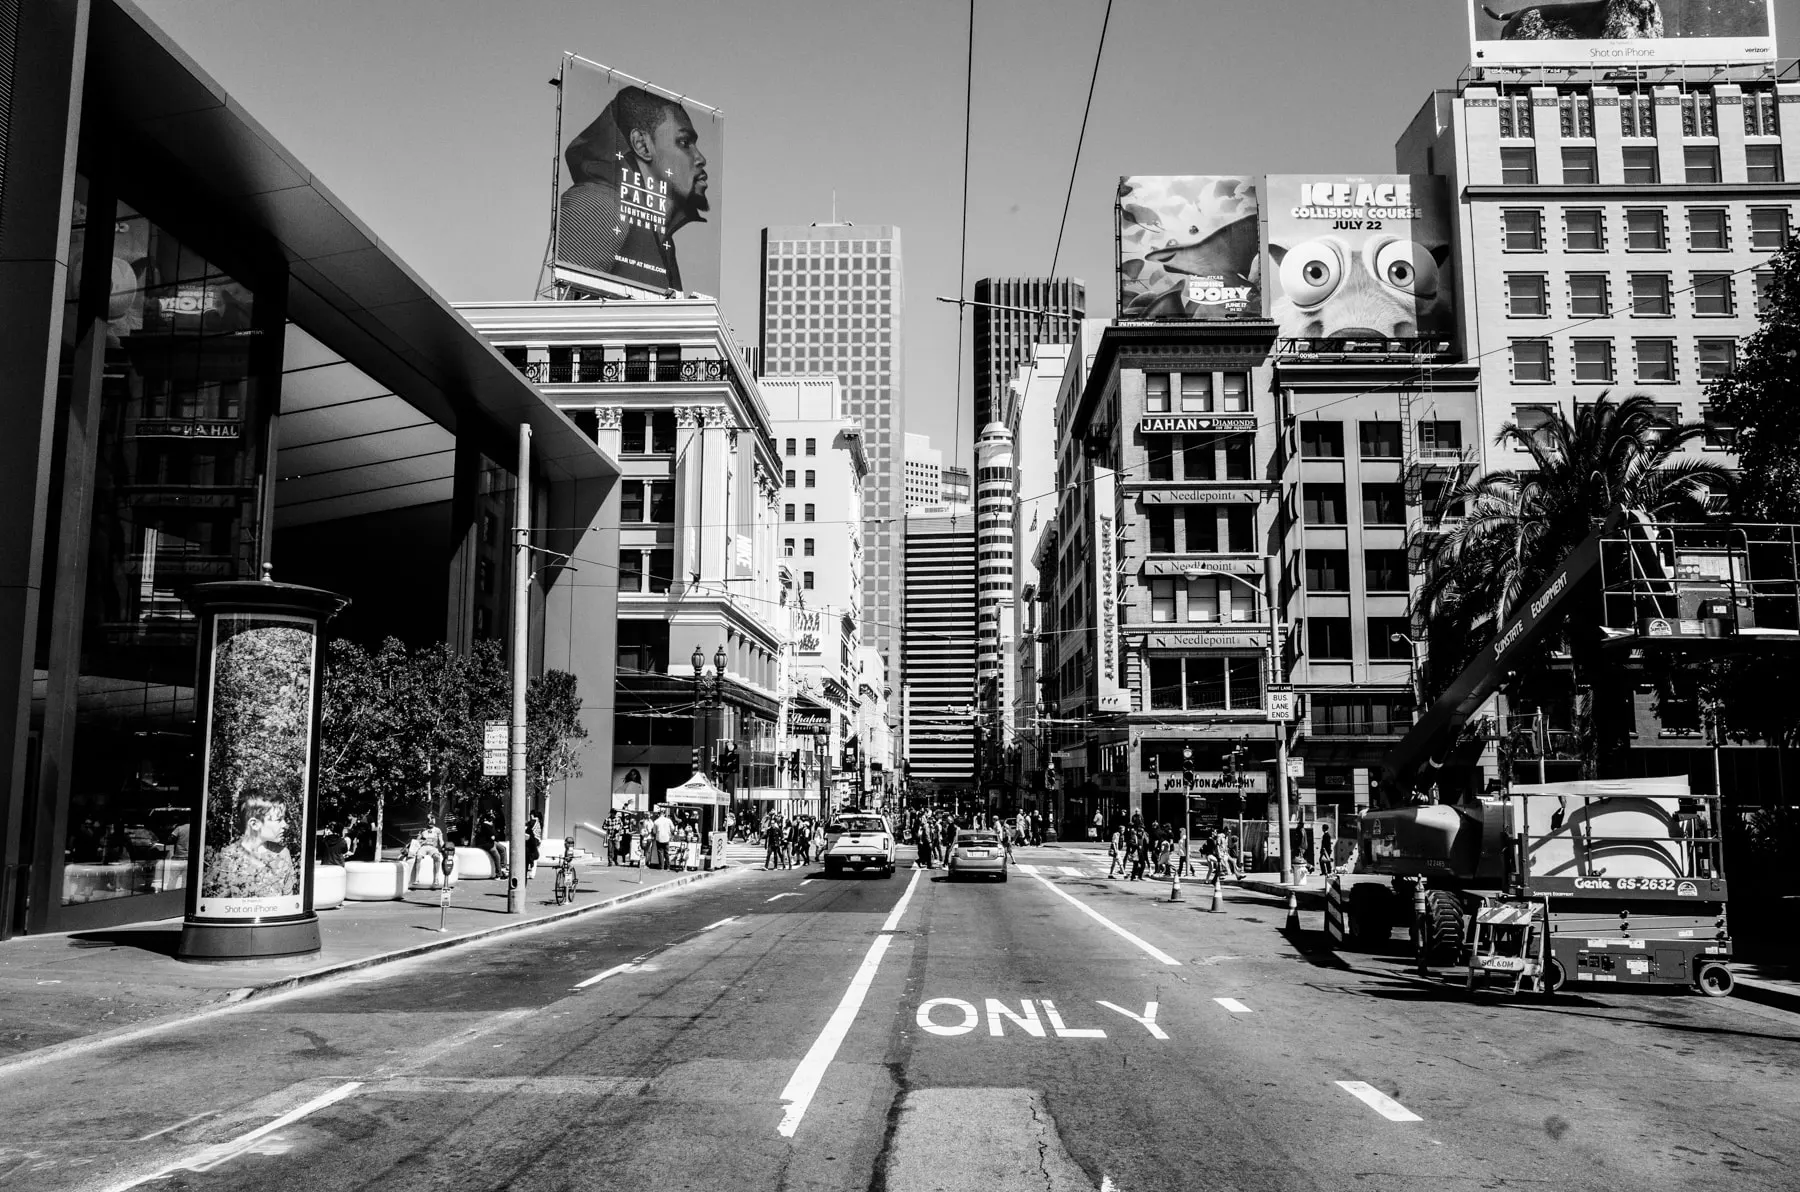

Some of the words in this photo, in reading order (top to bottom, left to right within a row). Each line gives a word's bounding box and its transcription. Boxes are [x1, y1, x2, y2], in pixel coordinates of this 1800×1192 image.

[1590, 49, 1610, 57] Shot
[1625, 48, 1655, 57] iPhone
[621, 168, 667, 194] TECH
[620, 185, 666, 212] PACK
[1301, 182, 1351, 207] ICE
[1355, 183, 1412, 207] AGE
[620, 204, 666, 225] LIGHTWEIGHT
[1291, 206, 1364, 219] COLLISION
[1367, 206, 1423, 220] COURSE
[619, 213, 666, 234] WARMTH
[1332, 220, 1363, 231] JULY
[1366, 220, 1383, 231] 22
[614, 254, 629, 264] GEAR
[628, 258, 637, 266] UP
[1189, 286, 1252, 301] DORY
[1143, 419, 1197, 431] JAHAN
[1212, 418, 1256, 427] DIAMONDS
[1170, 490, 1231, 502] Needlepoint
[1171, 560, 1232, 571] Needlpoint
[1494, 619, 1524, 661] SUNSTATE
[1530, 571, 1568, 619] EQUIPMENT
[1174, 634, 1235, 646] Needlepoint
[1164, 779, 1210, 791] JOHTON
[1220, 778, 1256, 788] MURHY
[1574, 878, 1611, 889] Genie
[1616, 879, 1676, 890] GS-2632
[224, 905, 241, 913] Shot
[254, 904, 278, 912] iPhone
[916, 997, 1170, 1040] ONLY
